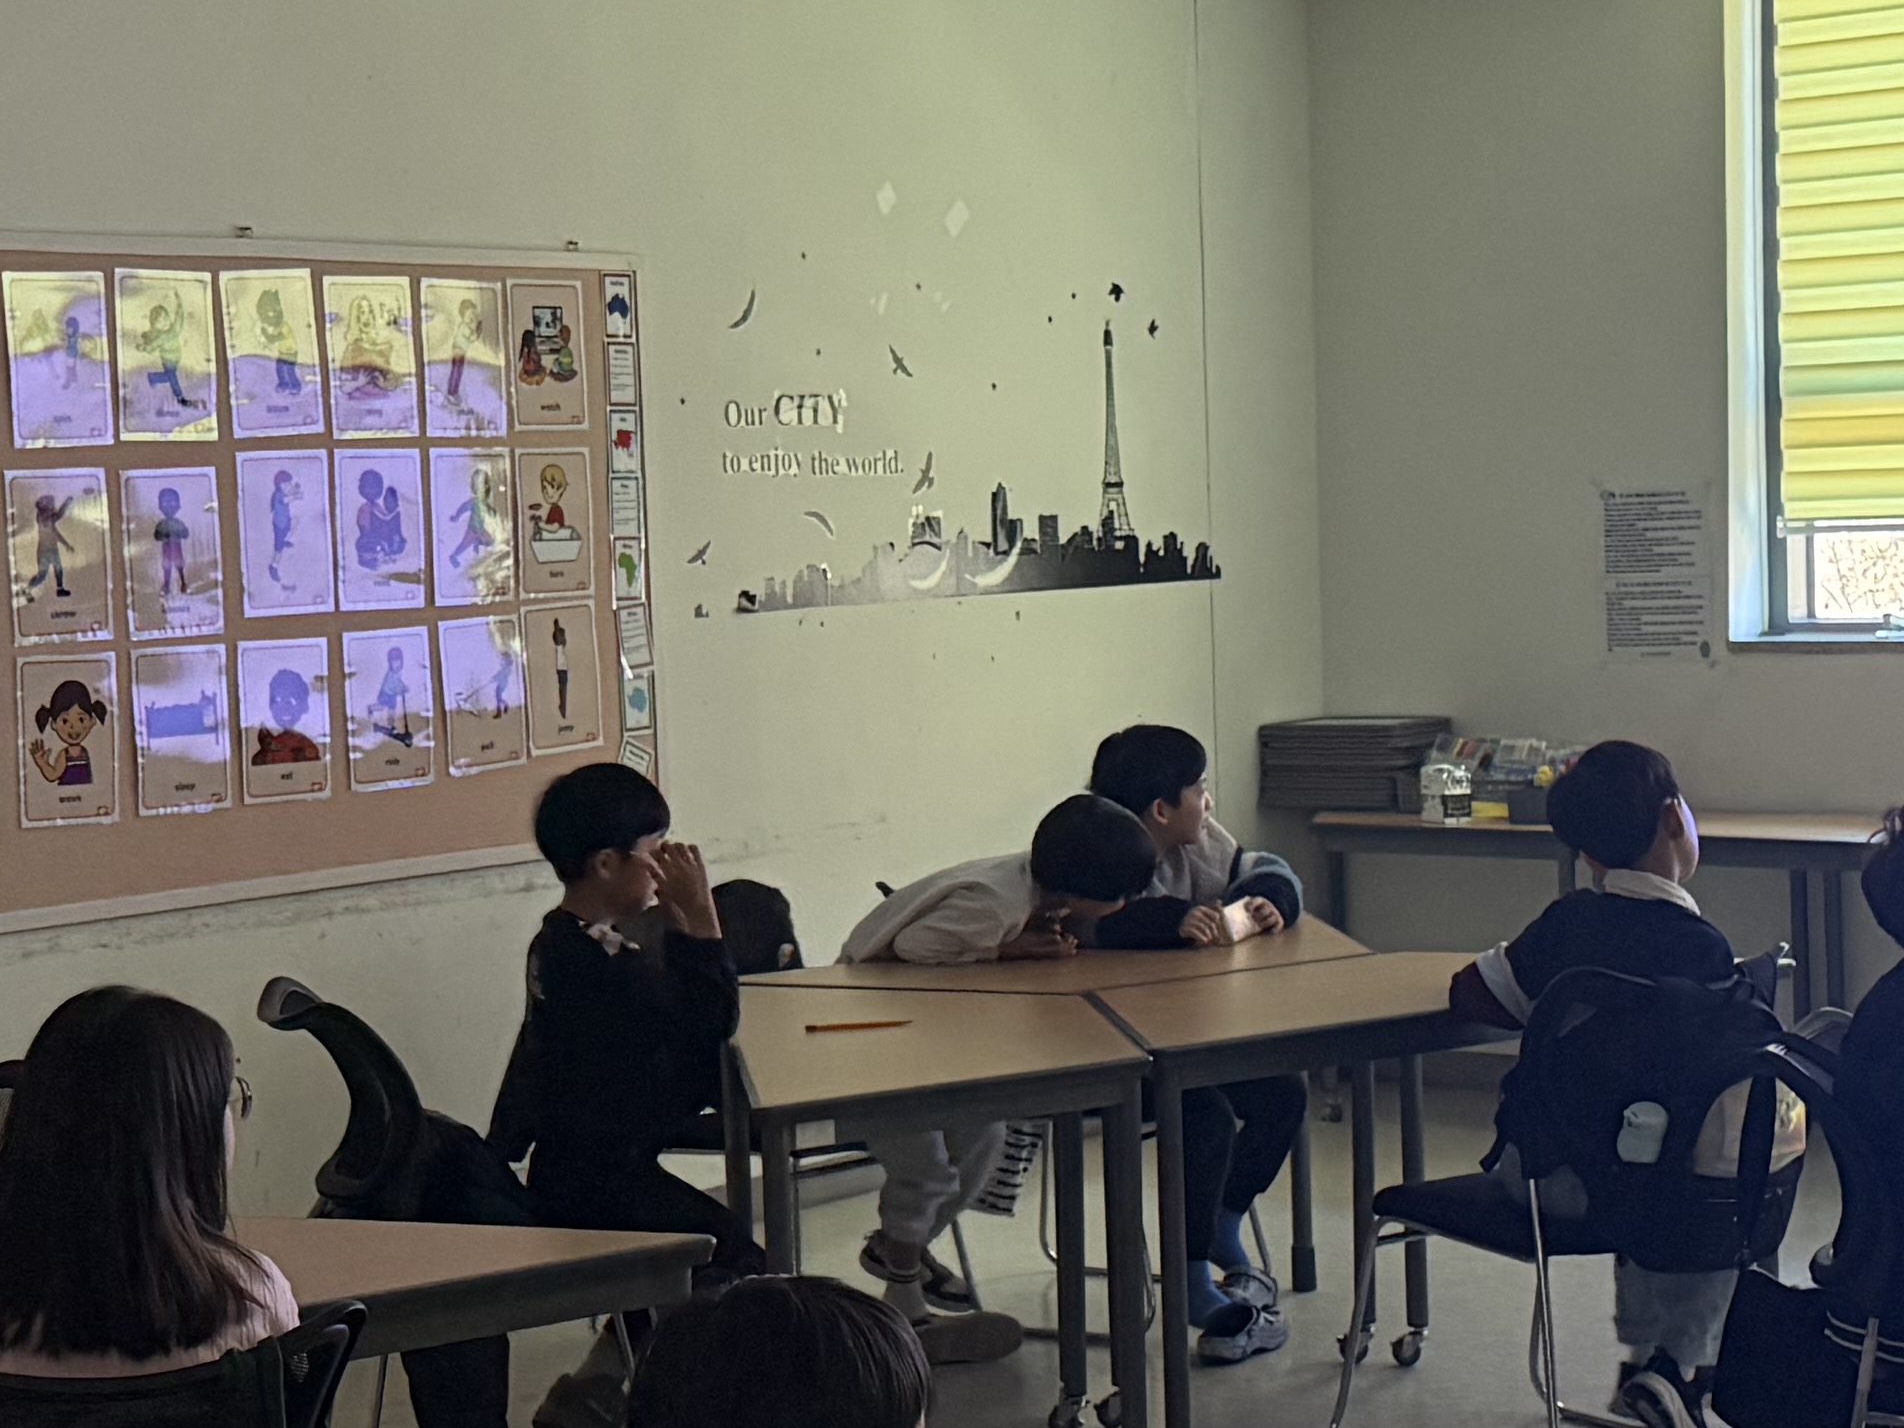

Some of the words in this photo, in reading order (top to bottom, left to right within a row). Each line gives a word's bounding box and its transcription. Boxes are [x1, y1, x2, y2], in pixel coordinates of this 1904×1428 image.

[724, 400, 767, 427] Our
[774, 394, 841, 427] CITY
[722, 451, 741, 474] to
[748, 446, 802, 478] enjoy
[811, 450, 840, 476] the
[846, 449, 904, 476] world.
